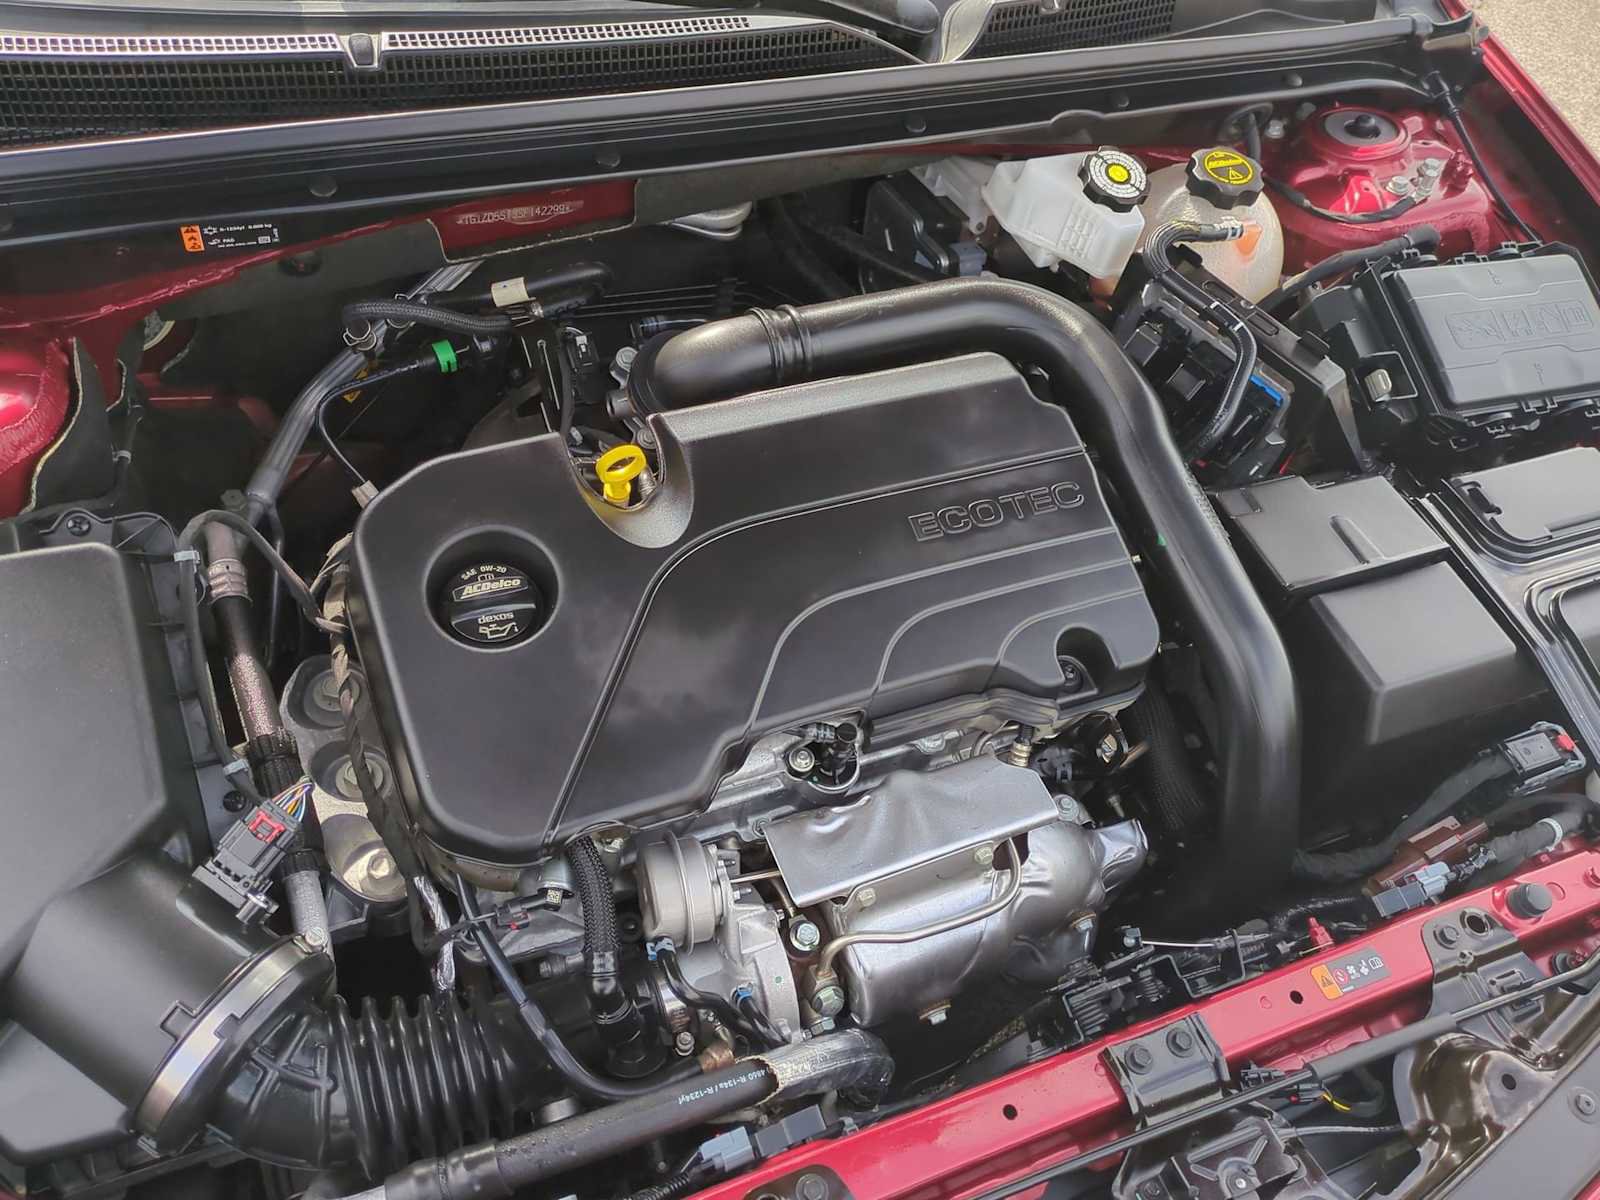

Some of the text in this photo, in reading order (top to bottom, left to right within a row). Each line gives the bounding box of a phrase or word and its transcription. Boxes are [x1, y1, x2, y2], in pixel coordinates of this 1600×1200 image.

[908, 481, 1085, 542] ECOTEC
[461, 565, 507, 581] SAE 0W-20
[462, 579, 521, 596] ACDelco
[478, 612, 515, 624] dexos
[678, 1086, 714, 1105] R-1234yf
